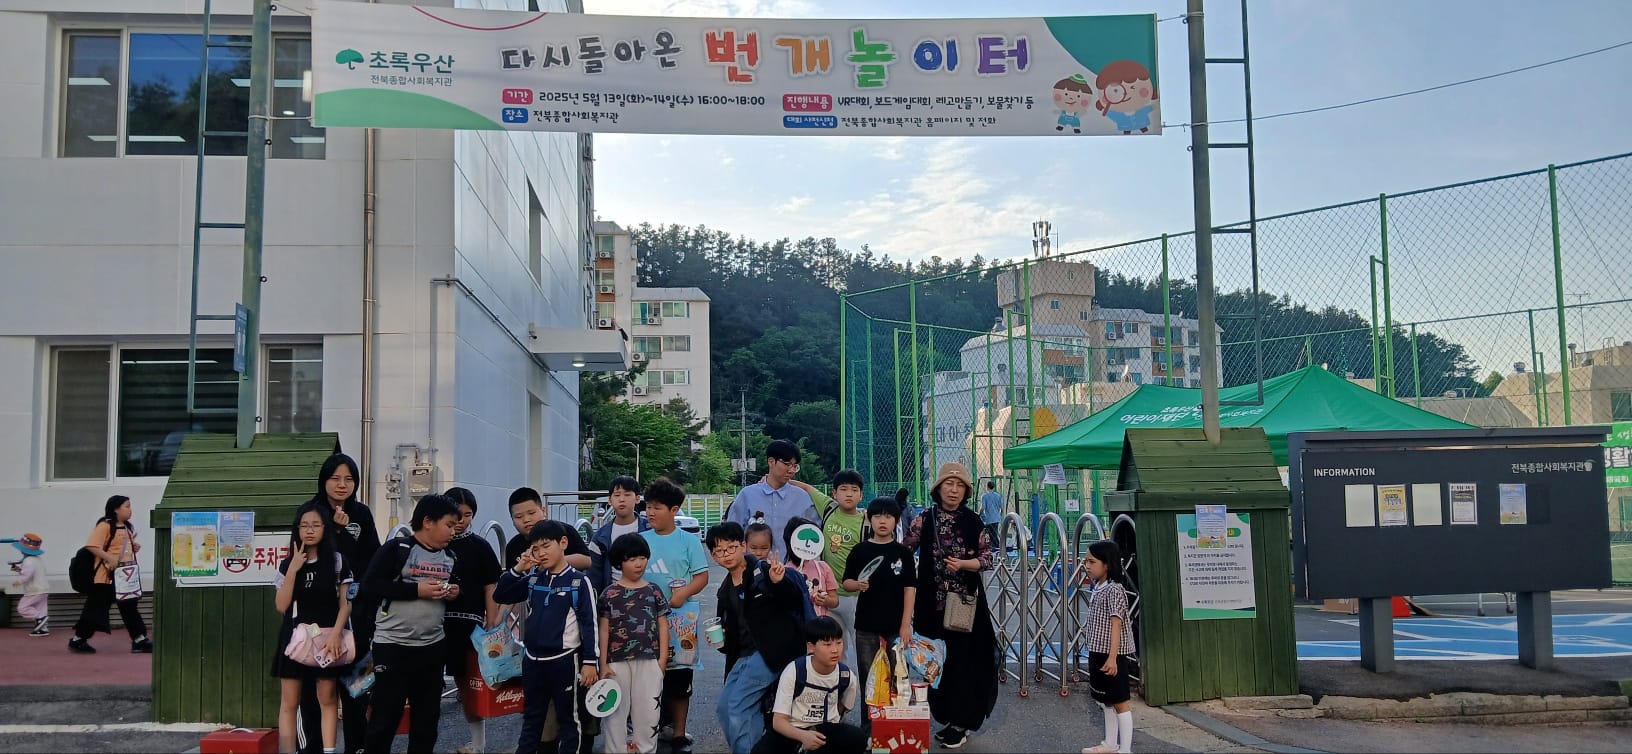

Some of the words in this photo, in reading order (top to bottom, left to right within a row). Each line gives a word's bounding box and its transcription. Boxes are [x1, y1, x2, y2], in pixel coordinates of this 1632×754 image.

[369, 51, 455, 73] 초록우산
[370, 75, 452, 87] 전북종합사회복지관
[507, 90, 529, 103] 기간
[539, 91, 579, 105] 2025년
[582, 92, 600, 107] 5월
[697, 95, 765, 106] 16:00~18:00
[786, 95, 830, 110] 진행내용
[874, 96, 934, 110] 보드게임대회,
[935, 96, 985, 110] 레고만들기,
[987, 96, 1023, 110] 보물찾기
[1025, 96, 1034, 110] 등
[505, 109, 525, 121] 장소
[533, 110, 619, 124] 전북종합사회복지관
[841, 116, 922, 128] 전북종합사회복지관
[926, 117, 962, 128] 홈페이지
[965, 117, 975, 128] 및
[978, 117, 996, 128] 전화
[1313, 467, 1376, 477] INFORMATION
[1511, 461, 1586, 474] 전북종합사회복지관
